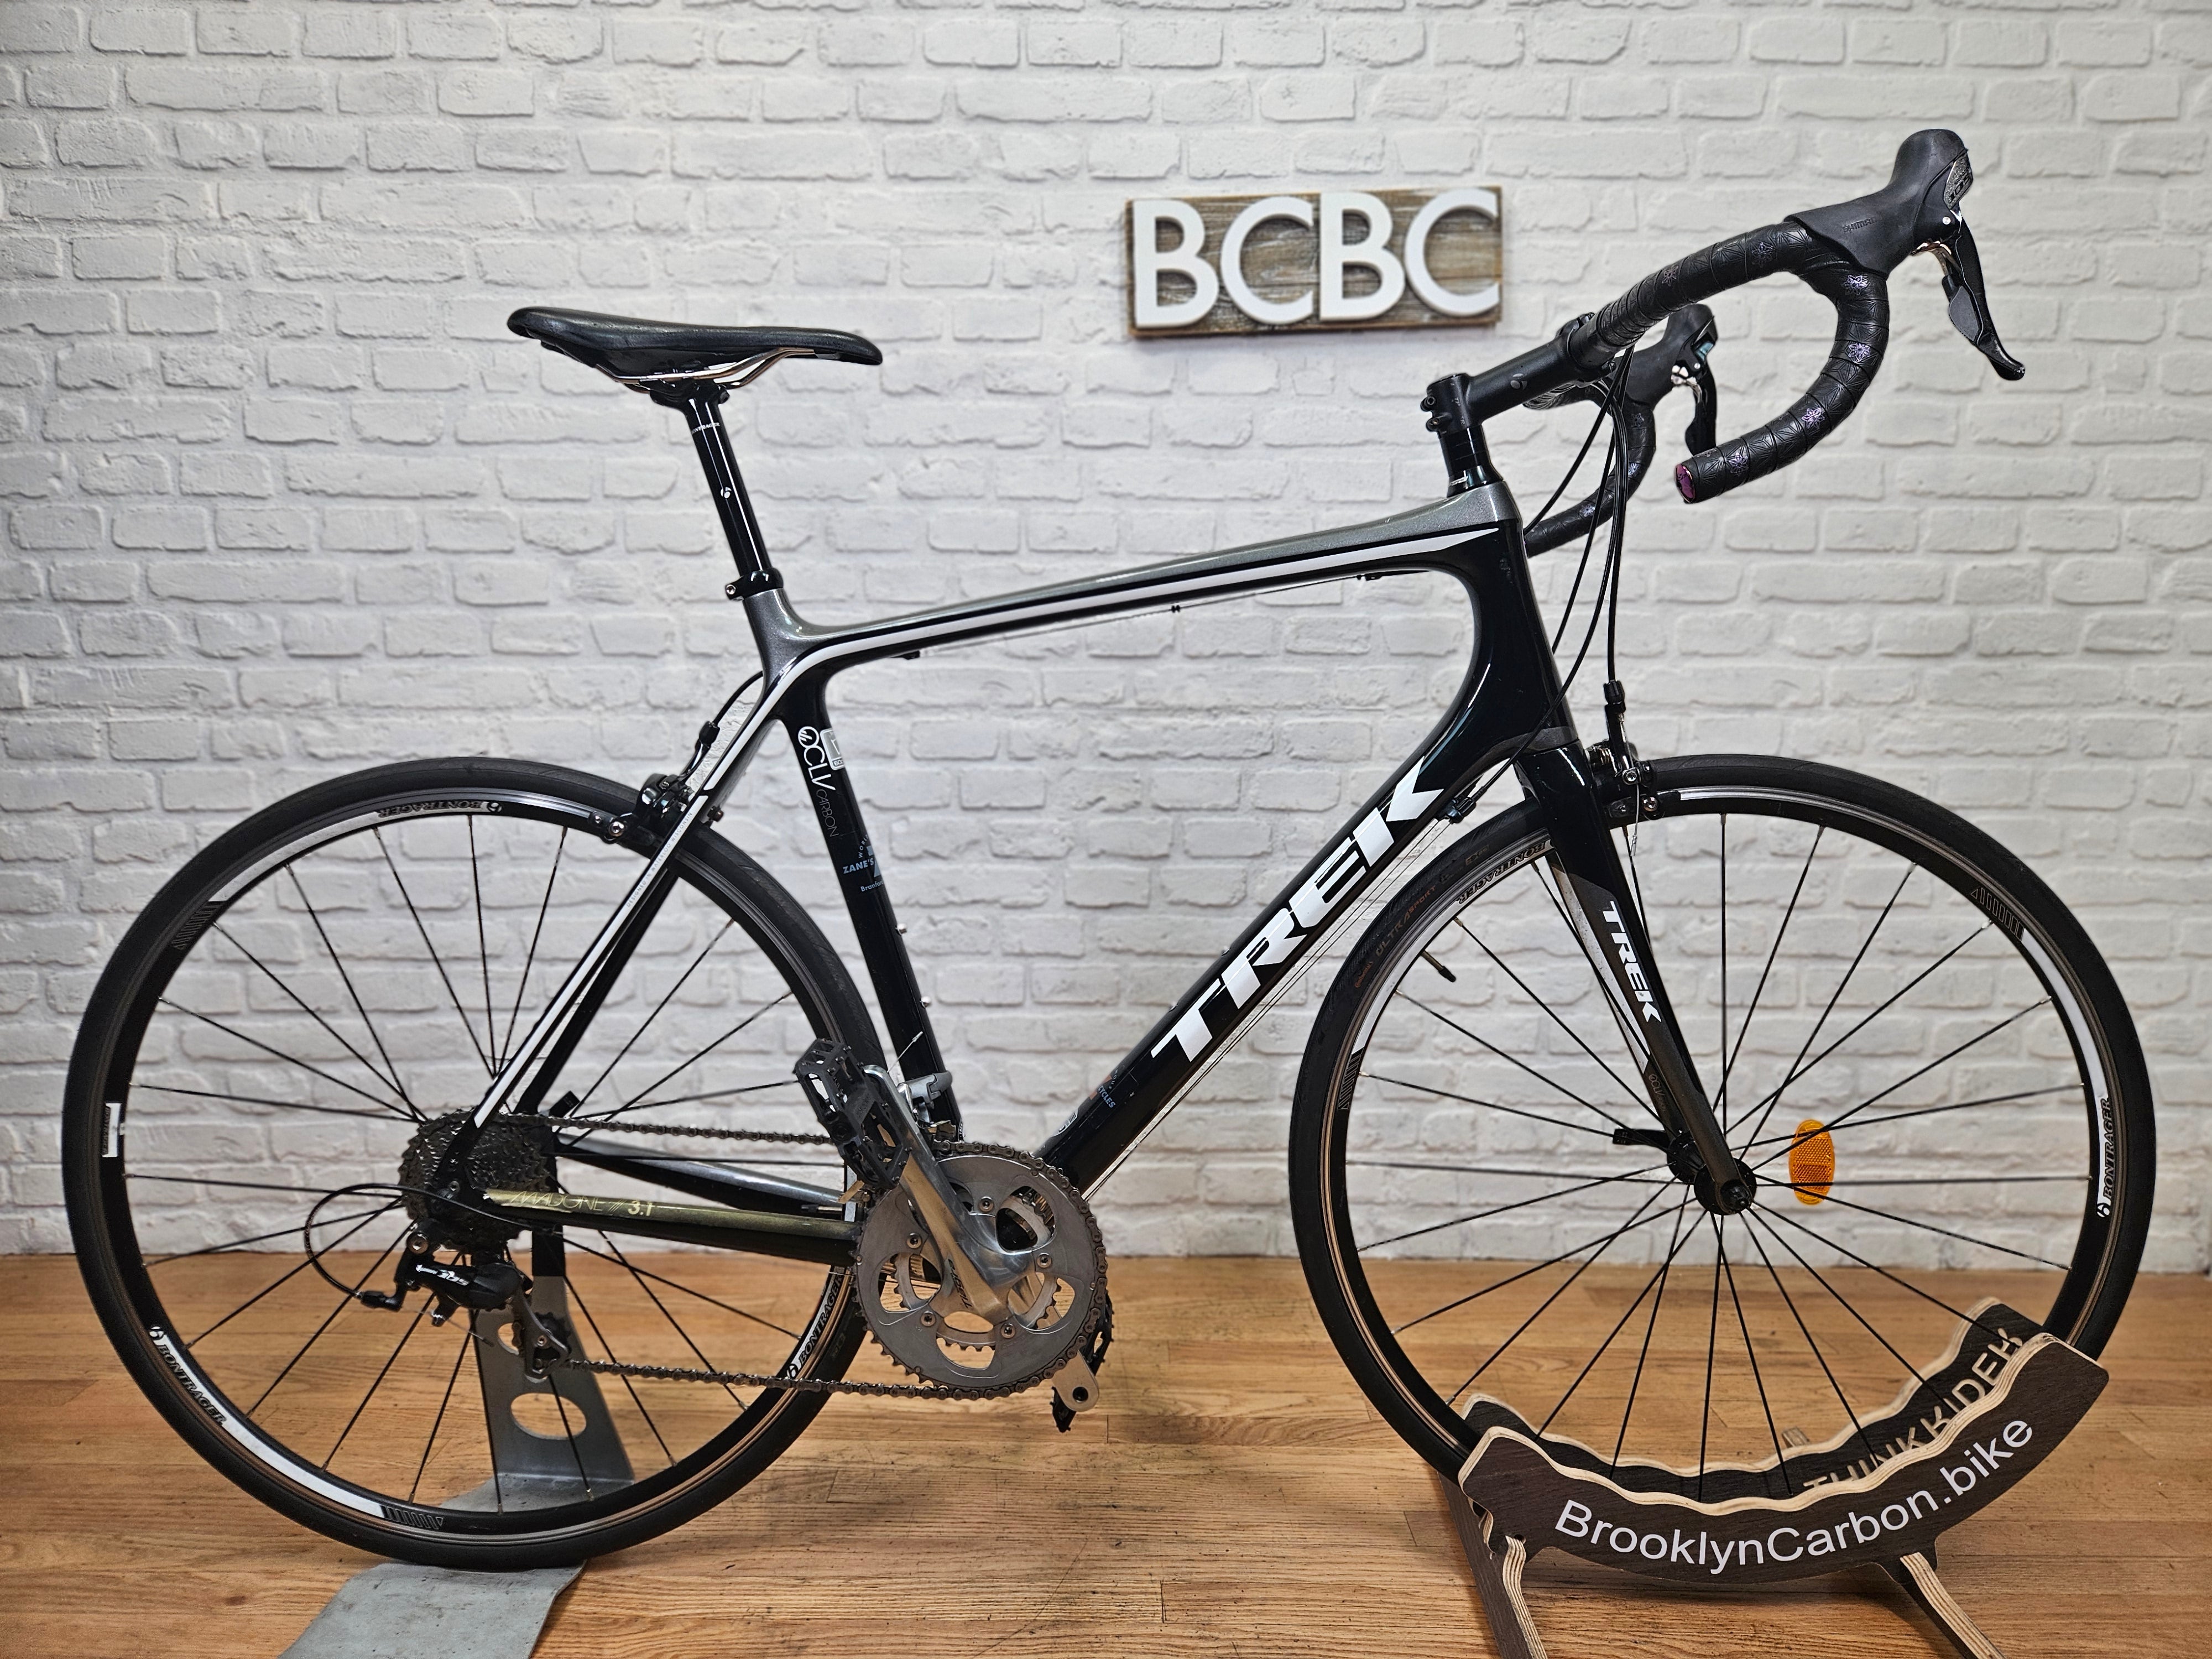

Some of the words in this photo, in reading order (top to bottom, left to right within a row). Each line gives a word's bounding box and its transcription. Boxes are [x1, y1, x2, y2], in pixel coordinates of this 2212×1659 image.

[1133, 188, 1500, 328] BCBC
[798, 726, 836, 791] OCLV
[378, 801, 483, 818] BONTRAGER
[816, 789, 839, 837] CARBON
[626, 880, 647, 907] DESIGNED
[671, 812, 692, 842] WISCONSIN
[843, 858, 874, 874] ZANE'S
[1457, 840, 1547, 904] BONTRAGER
[1150, 755, 1444, 1062] TREK
[1603, 901, 1662, 1022] TREK
[2100, 1098, 2115, 1200] BONTRAGER
[510, 1191, 605, 1211] MADONE
[627, 1199, 653, 1217] 3.1
[798, 1272, 845, 1366] BONTRAGER
[158, 1344, 227, 1426] BONTRAGER
[1554, 1420, 2033, 1575] BrooklynCarbon.bike
